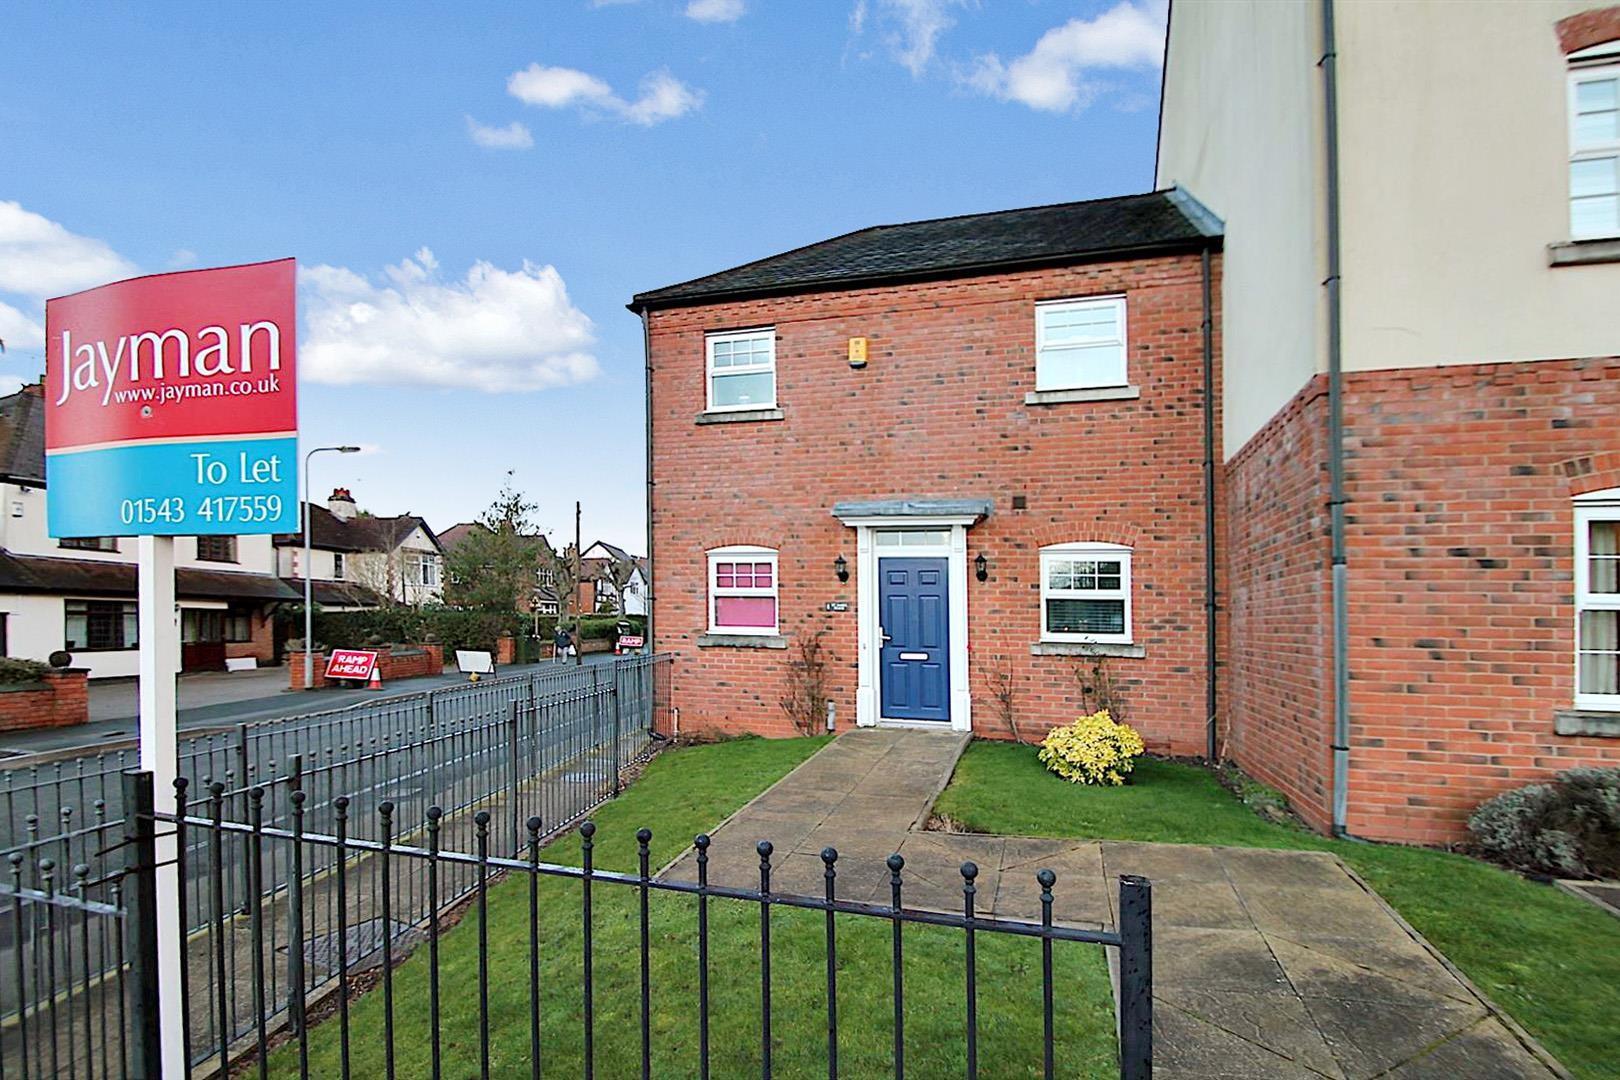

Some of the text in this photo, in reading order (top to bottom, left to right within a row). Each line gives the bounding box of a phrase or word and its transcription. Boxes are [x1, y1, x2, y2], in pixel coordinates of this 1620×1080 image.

[56, 320, 281, 406] Jayman
[115, 373, 280, 404] www.jayman.co.uk
[190, 452, 281, 484] To Let
[121, 495, 282, 524] 01543 417559
[331, 664, 368, 673] AHEAD
[338, 655, 368, 664] RAMP
